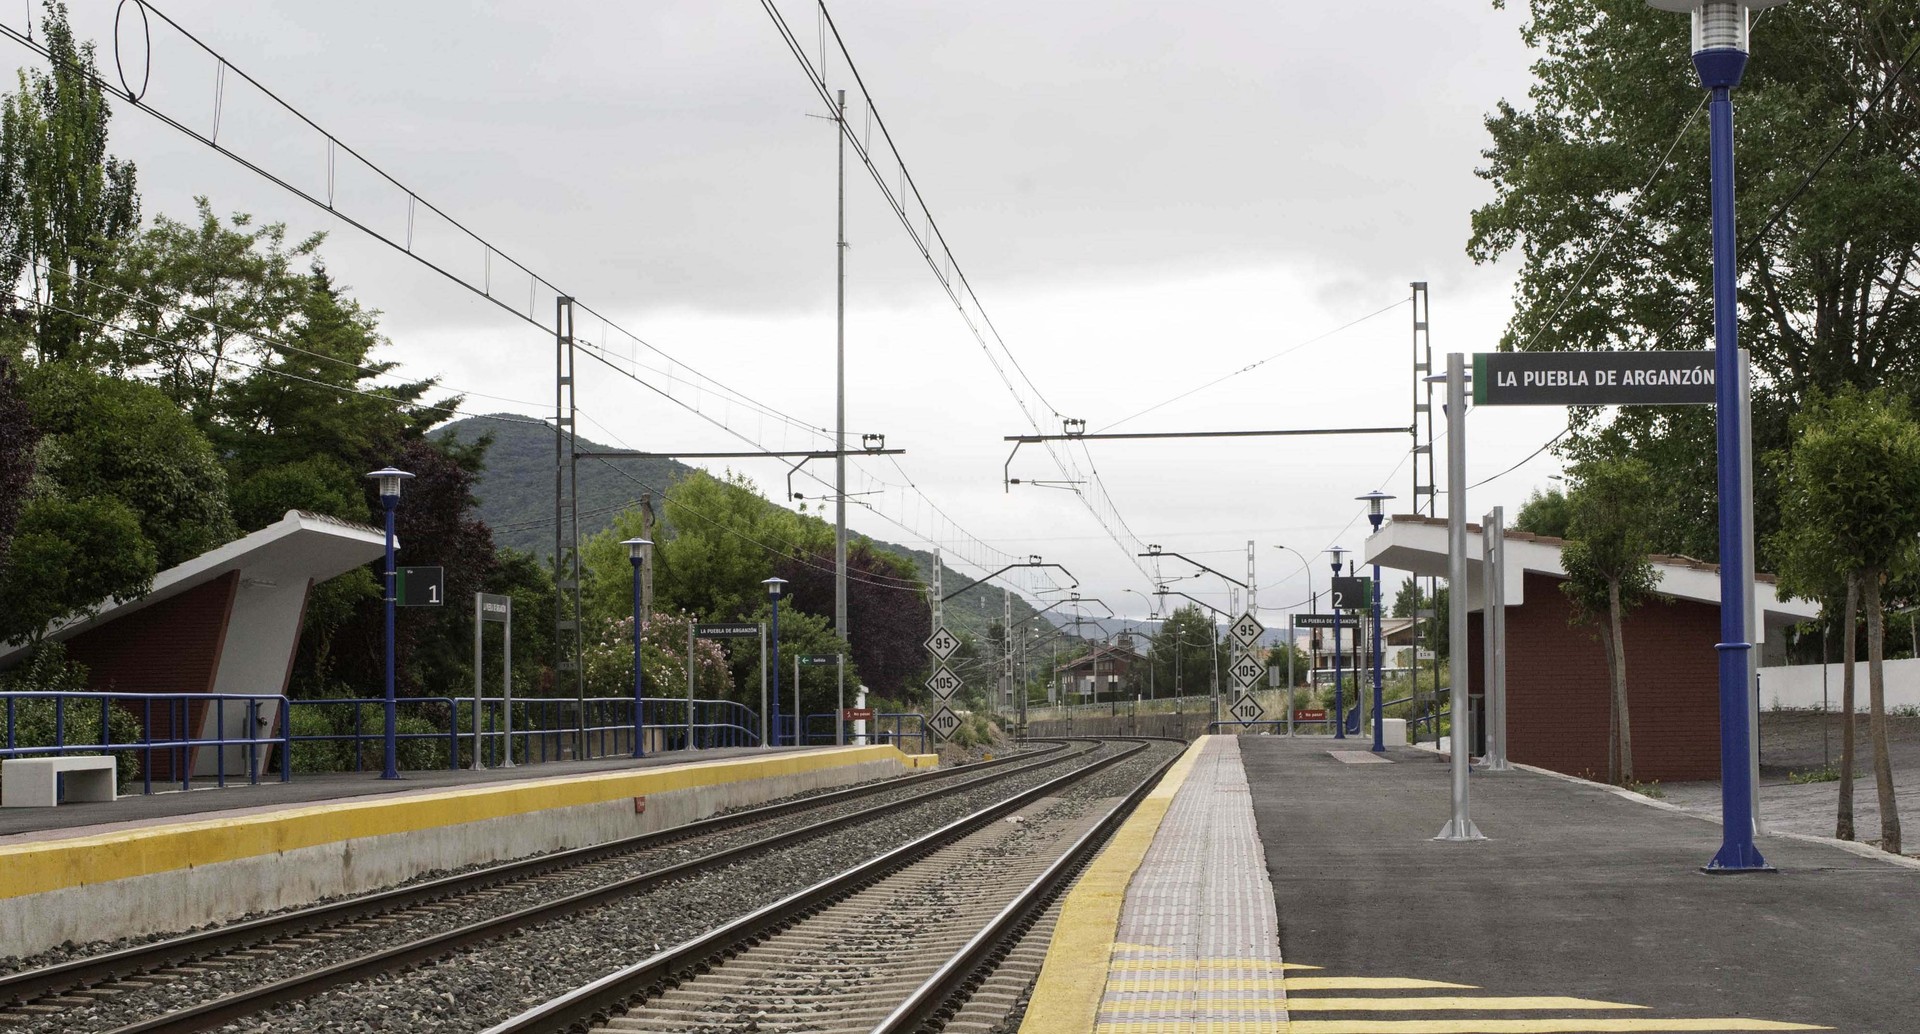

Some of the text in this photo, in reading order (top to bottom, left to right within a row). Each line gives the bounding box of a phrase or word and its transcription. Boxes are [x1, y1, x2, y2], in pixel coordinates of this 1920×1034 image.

[1497, 366, 1715, 387] LA PUEBLA DE ARGANZÓN
[429, 585, 439, 603] 1
[1333, 591, 1343, 607] 2
[1240, 624, 1255, 636] 95
[935, 637, 951, 649] 95
[1237, 665, 1256, 677] 105
[934, 677, 953, 689] 105
[1239, 705, 1256, 717] 110
[937, 716, 954, 728] 110
